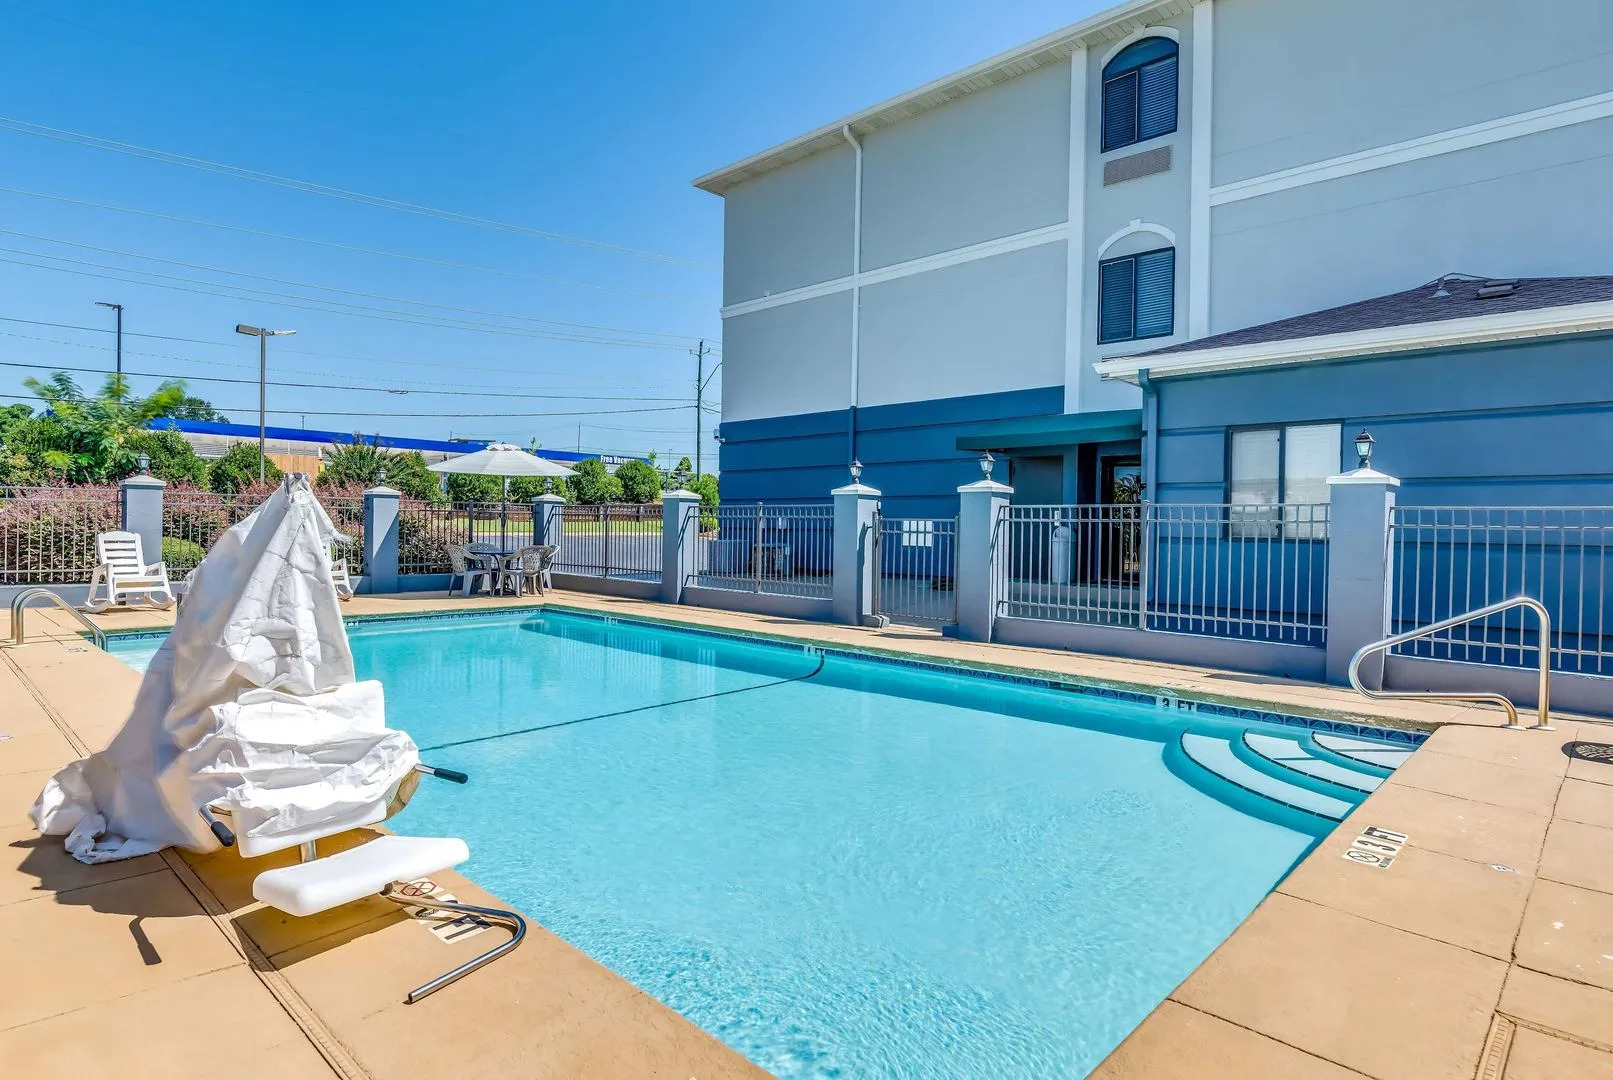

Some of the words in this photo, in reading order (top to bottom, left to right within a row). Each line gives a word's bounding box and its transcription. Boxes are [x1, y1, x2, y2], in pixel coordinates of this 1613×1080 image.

[600, 455, 613, 464] Free
[1177, 699, 1195, 711] FT
[1363, 826, 1406, 844] FT
[1356, 839, 1397, 852] 3
[432, 913, 492, 941] FT
